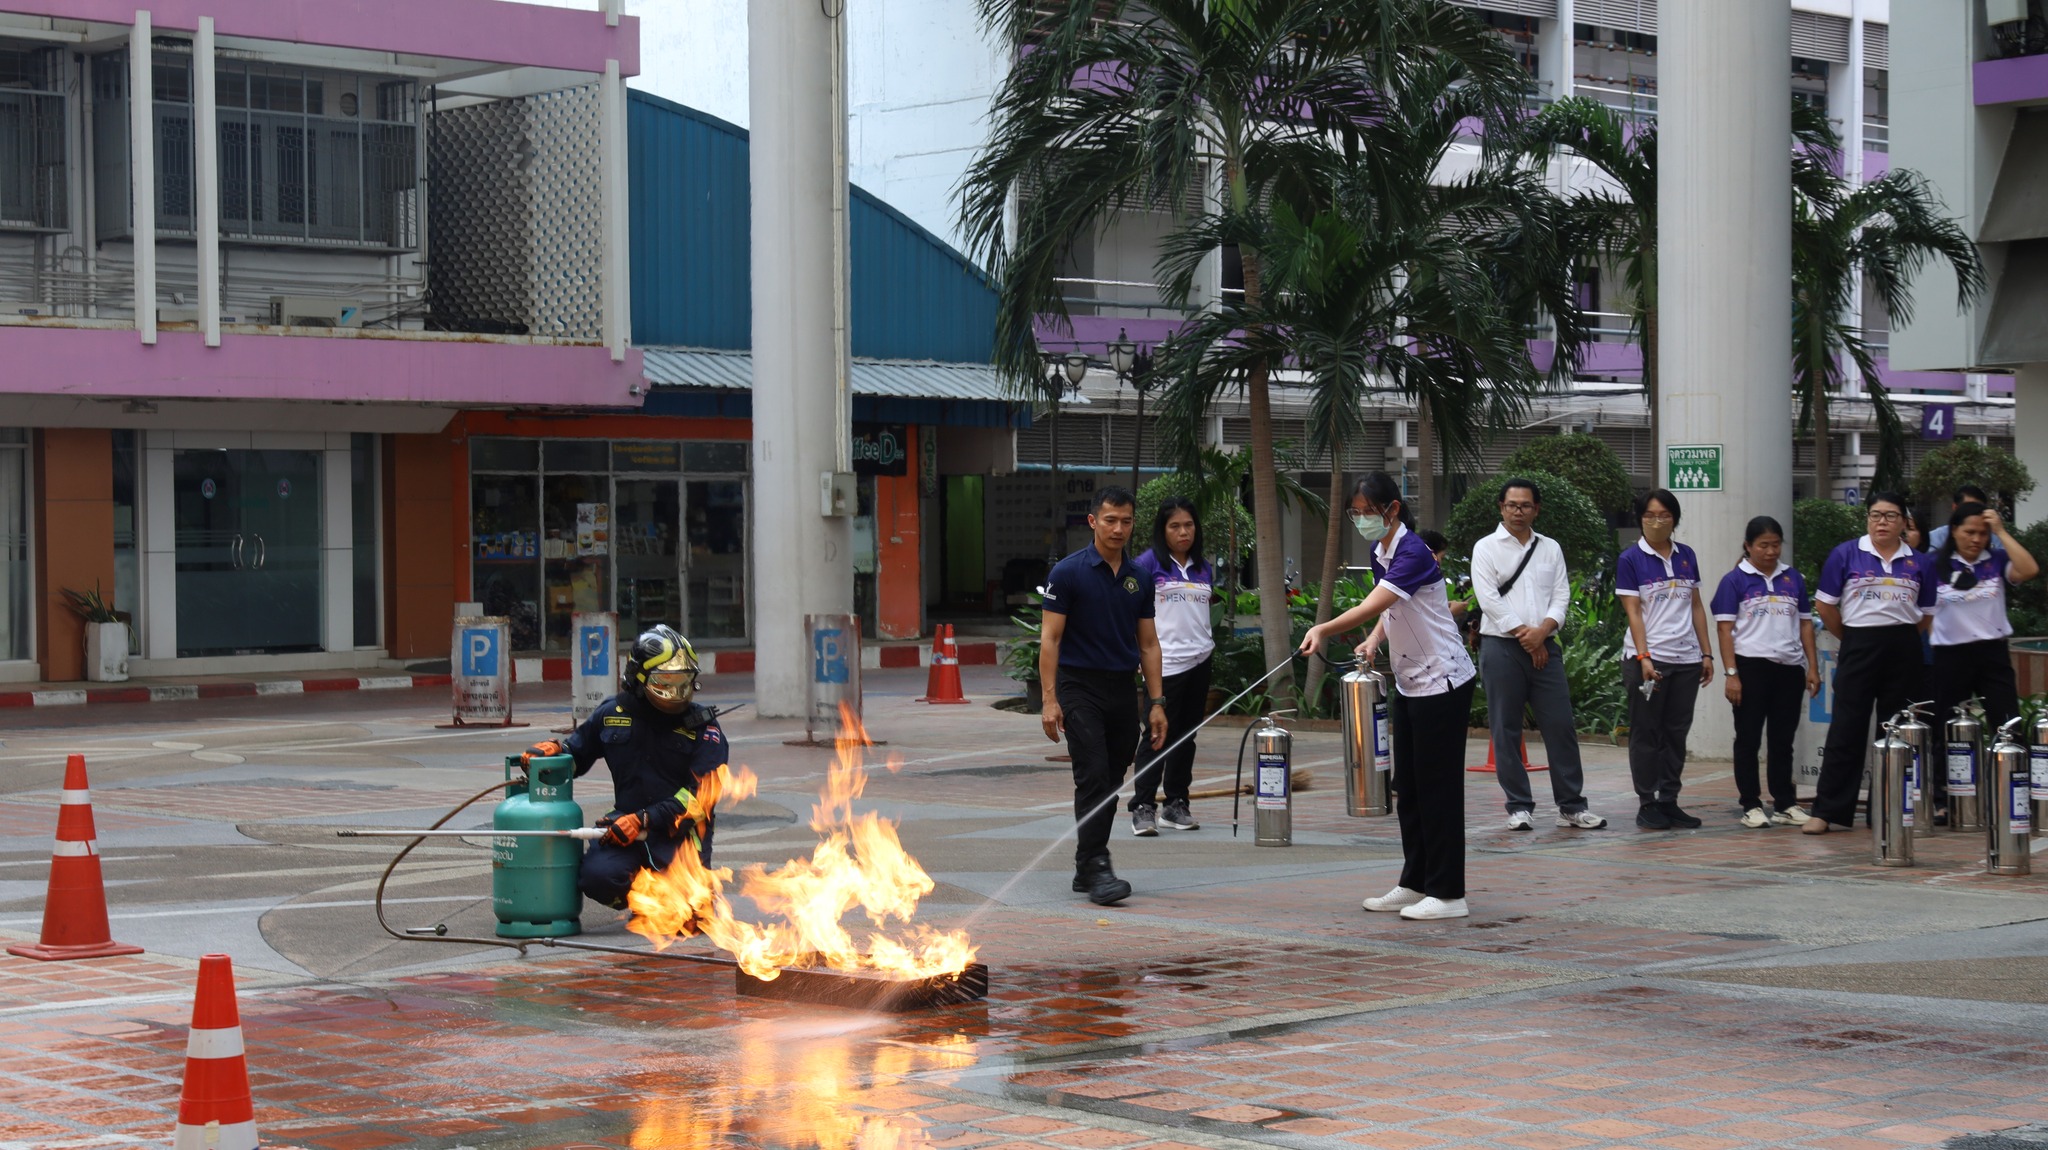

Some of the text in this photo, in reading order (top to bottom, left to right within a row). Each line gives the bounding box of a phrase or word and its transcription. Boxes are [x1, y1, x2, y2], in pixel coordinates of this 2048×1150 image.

[1928, 409, 1944, 435] 4
[470, 635, 491, 670] P
[587, 632, 604, 670] P
[822, 636, 842, 677] P
[535, 787, 557, 796] 16.2
